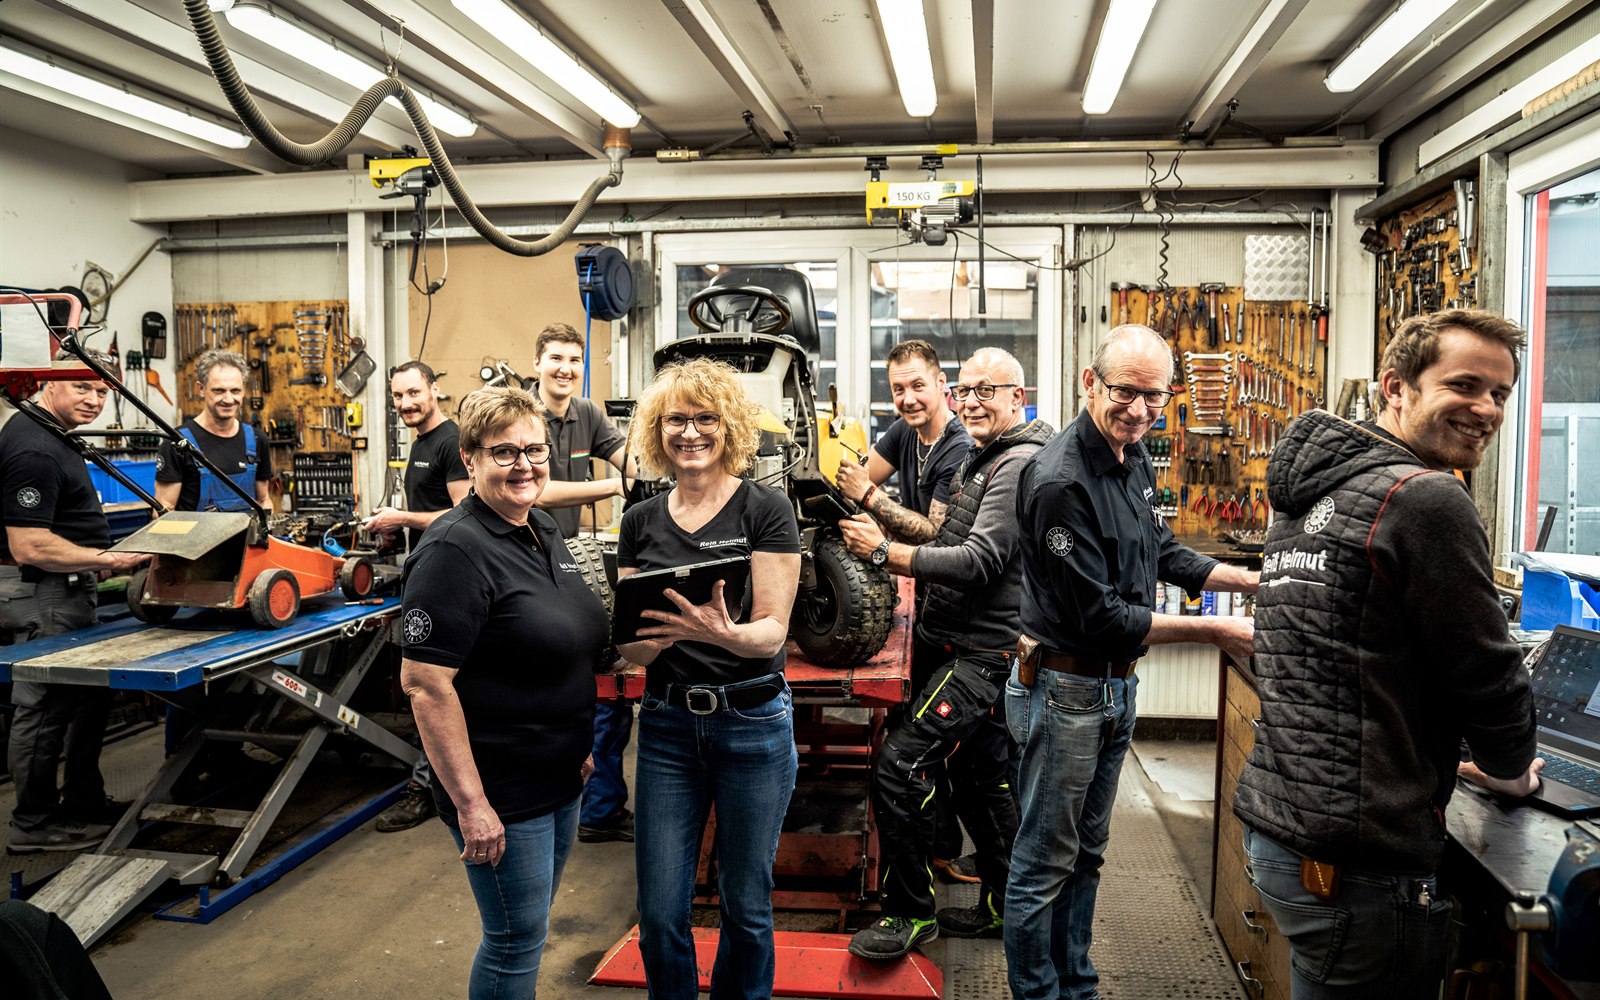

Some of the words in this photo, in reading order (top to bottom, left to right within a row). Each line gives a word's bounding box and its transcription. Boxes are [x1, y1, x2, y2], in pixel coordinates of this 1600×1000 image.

[897, 192, 914, 201] 150
[917, 192, 931, 201] KG
[1279, 547, 1328, 572] Helmut
[284, 678, 299, 691] 600
